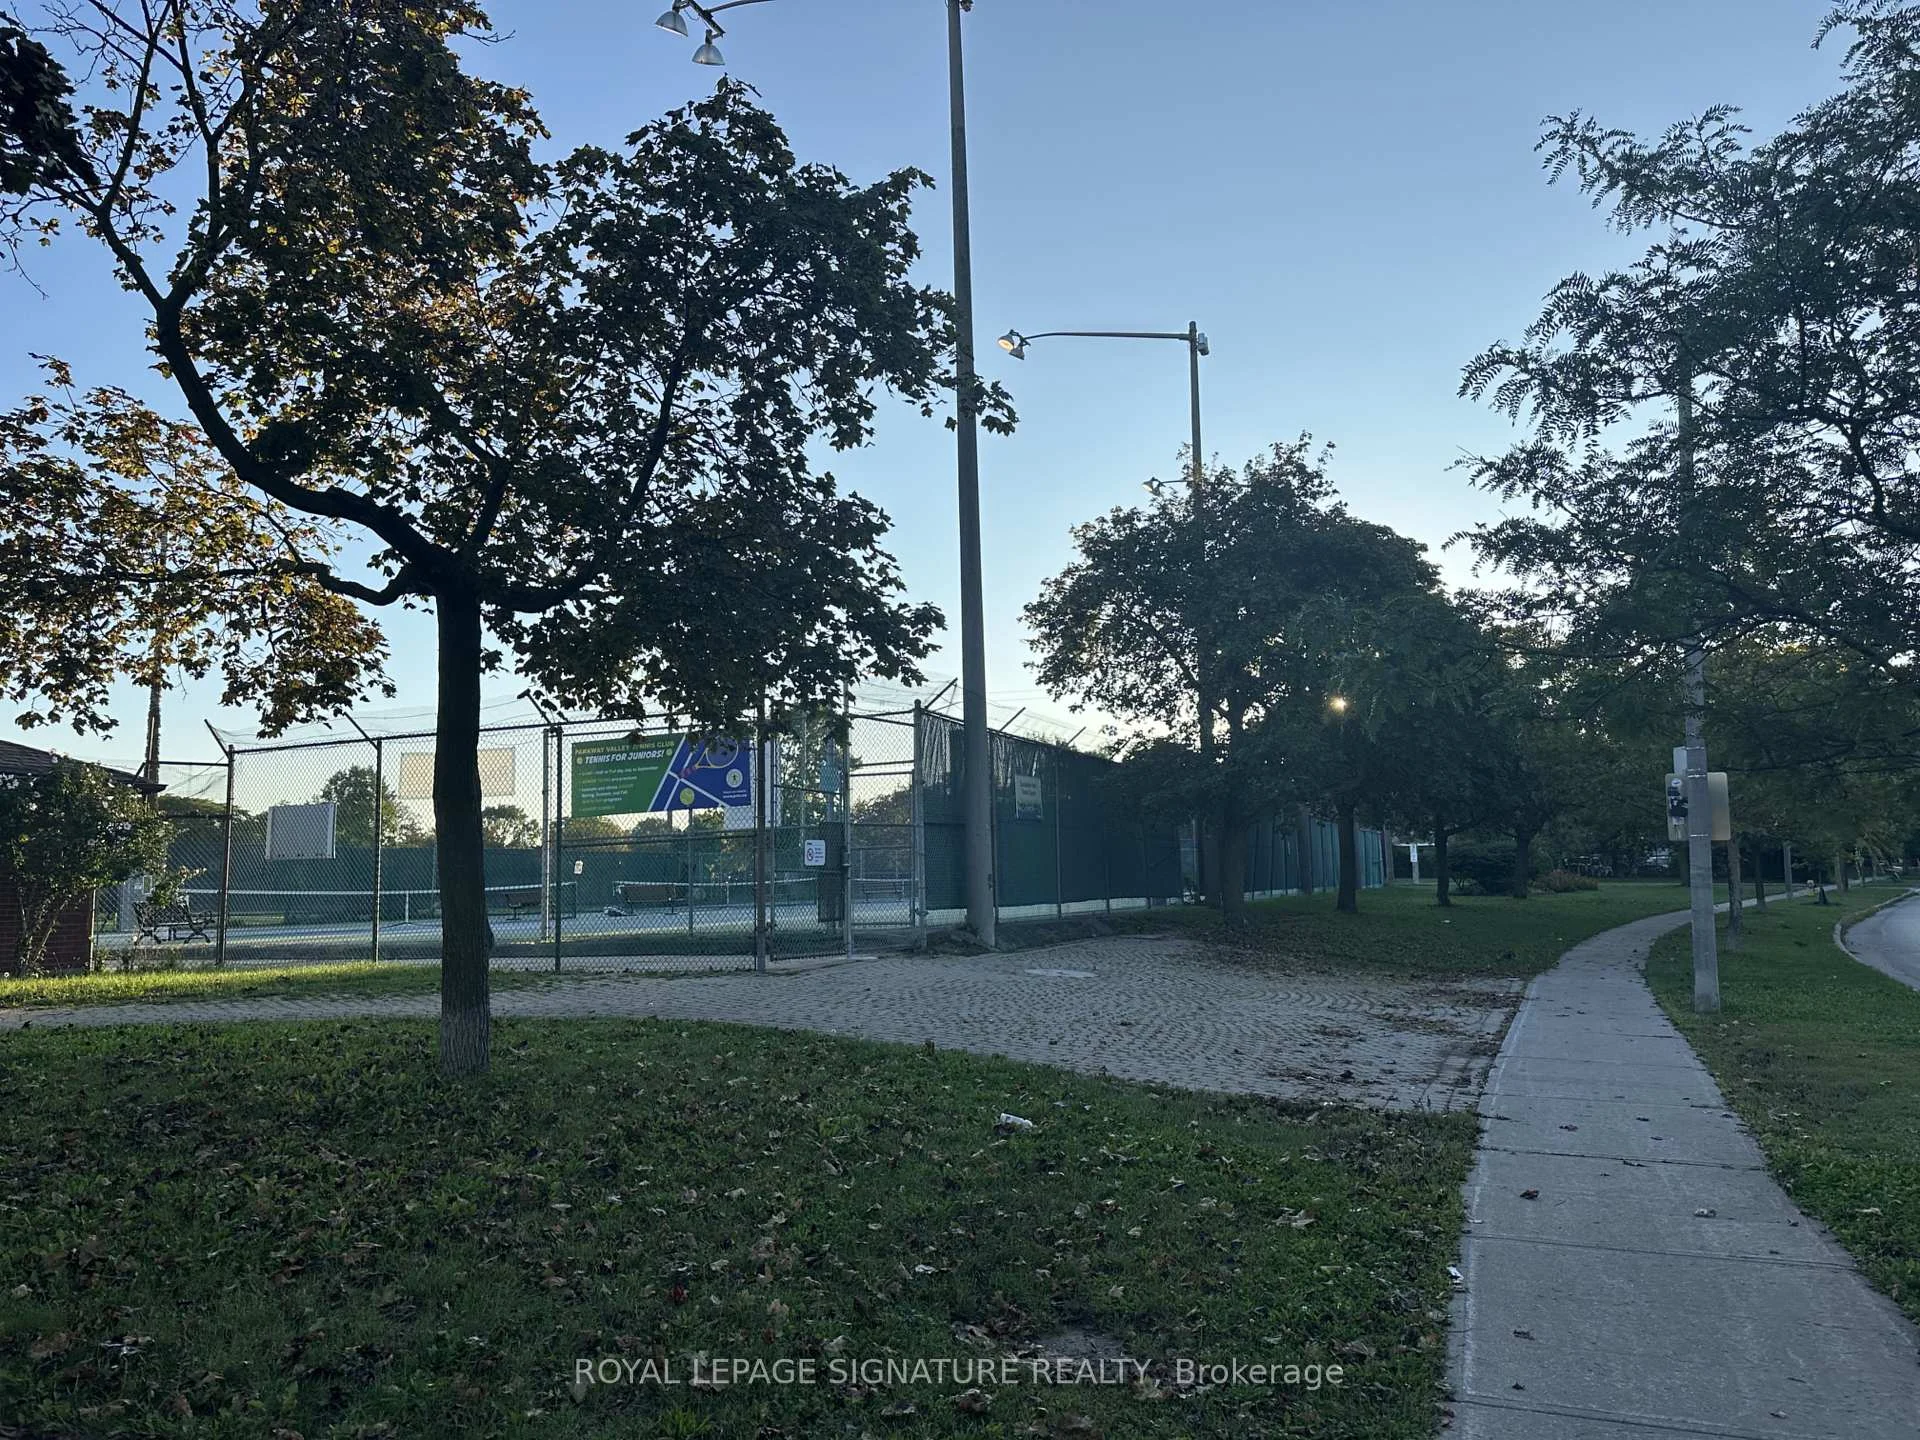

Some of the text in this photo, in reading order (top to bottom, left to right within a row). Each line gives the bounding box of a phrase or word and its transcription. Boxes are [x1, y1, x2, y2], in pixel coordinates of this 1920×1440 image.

[585, 749, 665, 764] TENNIS FOR JUNIORS!
